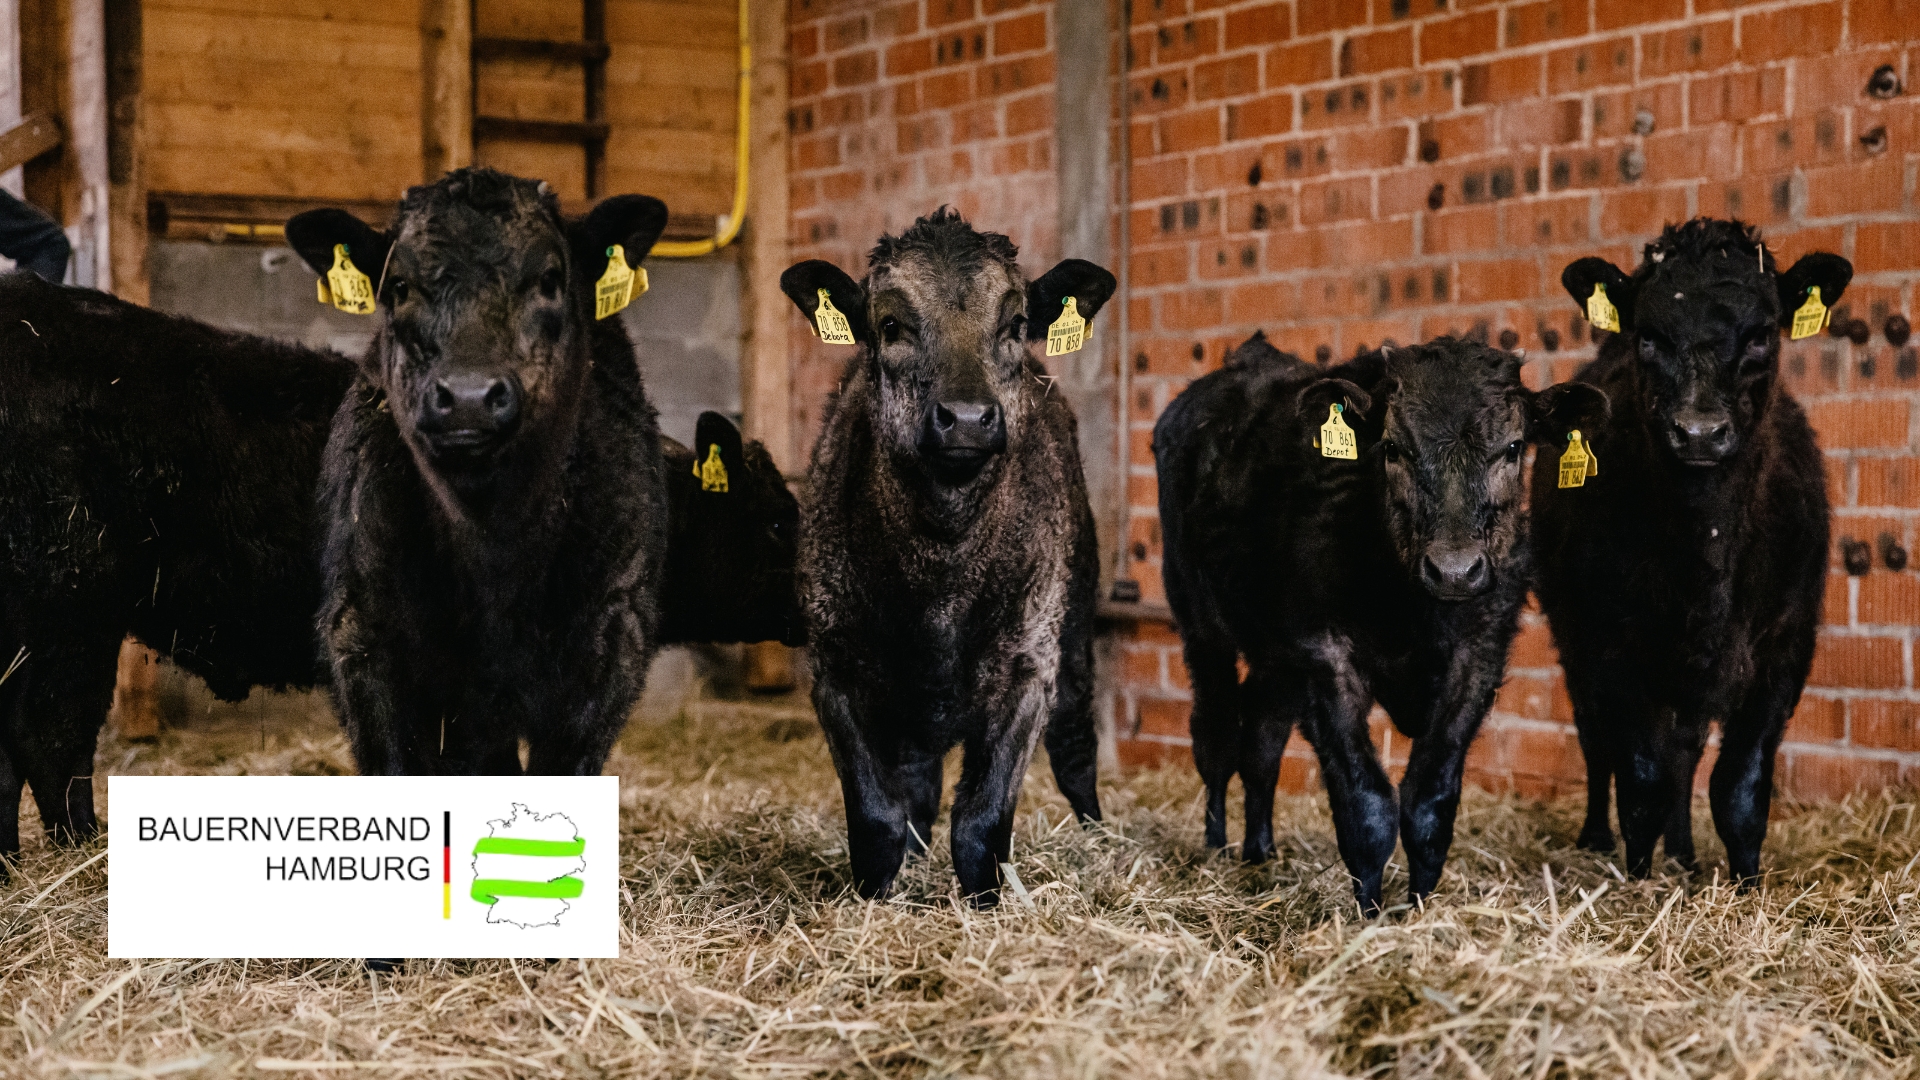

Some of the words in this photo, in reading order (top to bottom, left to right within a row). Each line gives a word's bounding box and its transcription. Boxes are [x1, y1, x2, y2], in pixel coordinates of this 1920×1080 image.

[350, 279, 370, 298] 863
[598, 295, 611, 316] 70
[817, 314, 830, 331] 70
[832, 316, 849, 332] 858
[1049, 337, 1062, 354] 70
[1065, 332, 1081, 351] 858
[1332, 415, 1338, 425] 6
[1323, 429, 1333, 445] 70
[1339, 431, 1354, 447] 861
[1324, 446, 1350, 457] Depot
[1560, 470, 1570, 486] 70
